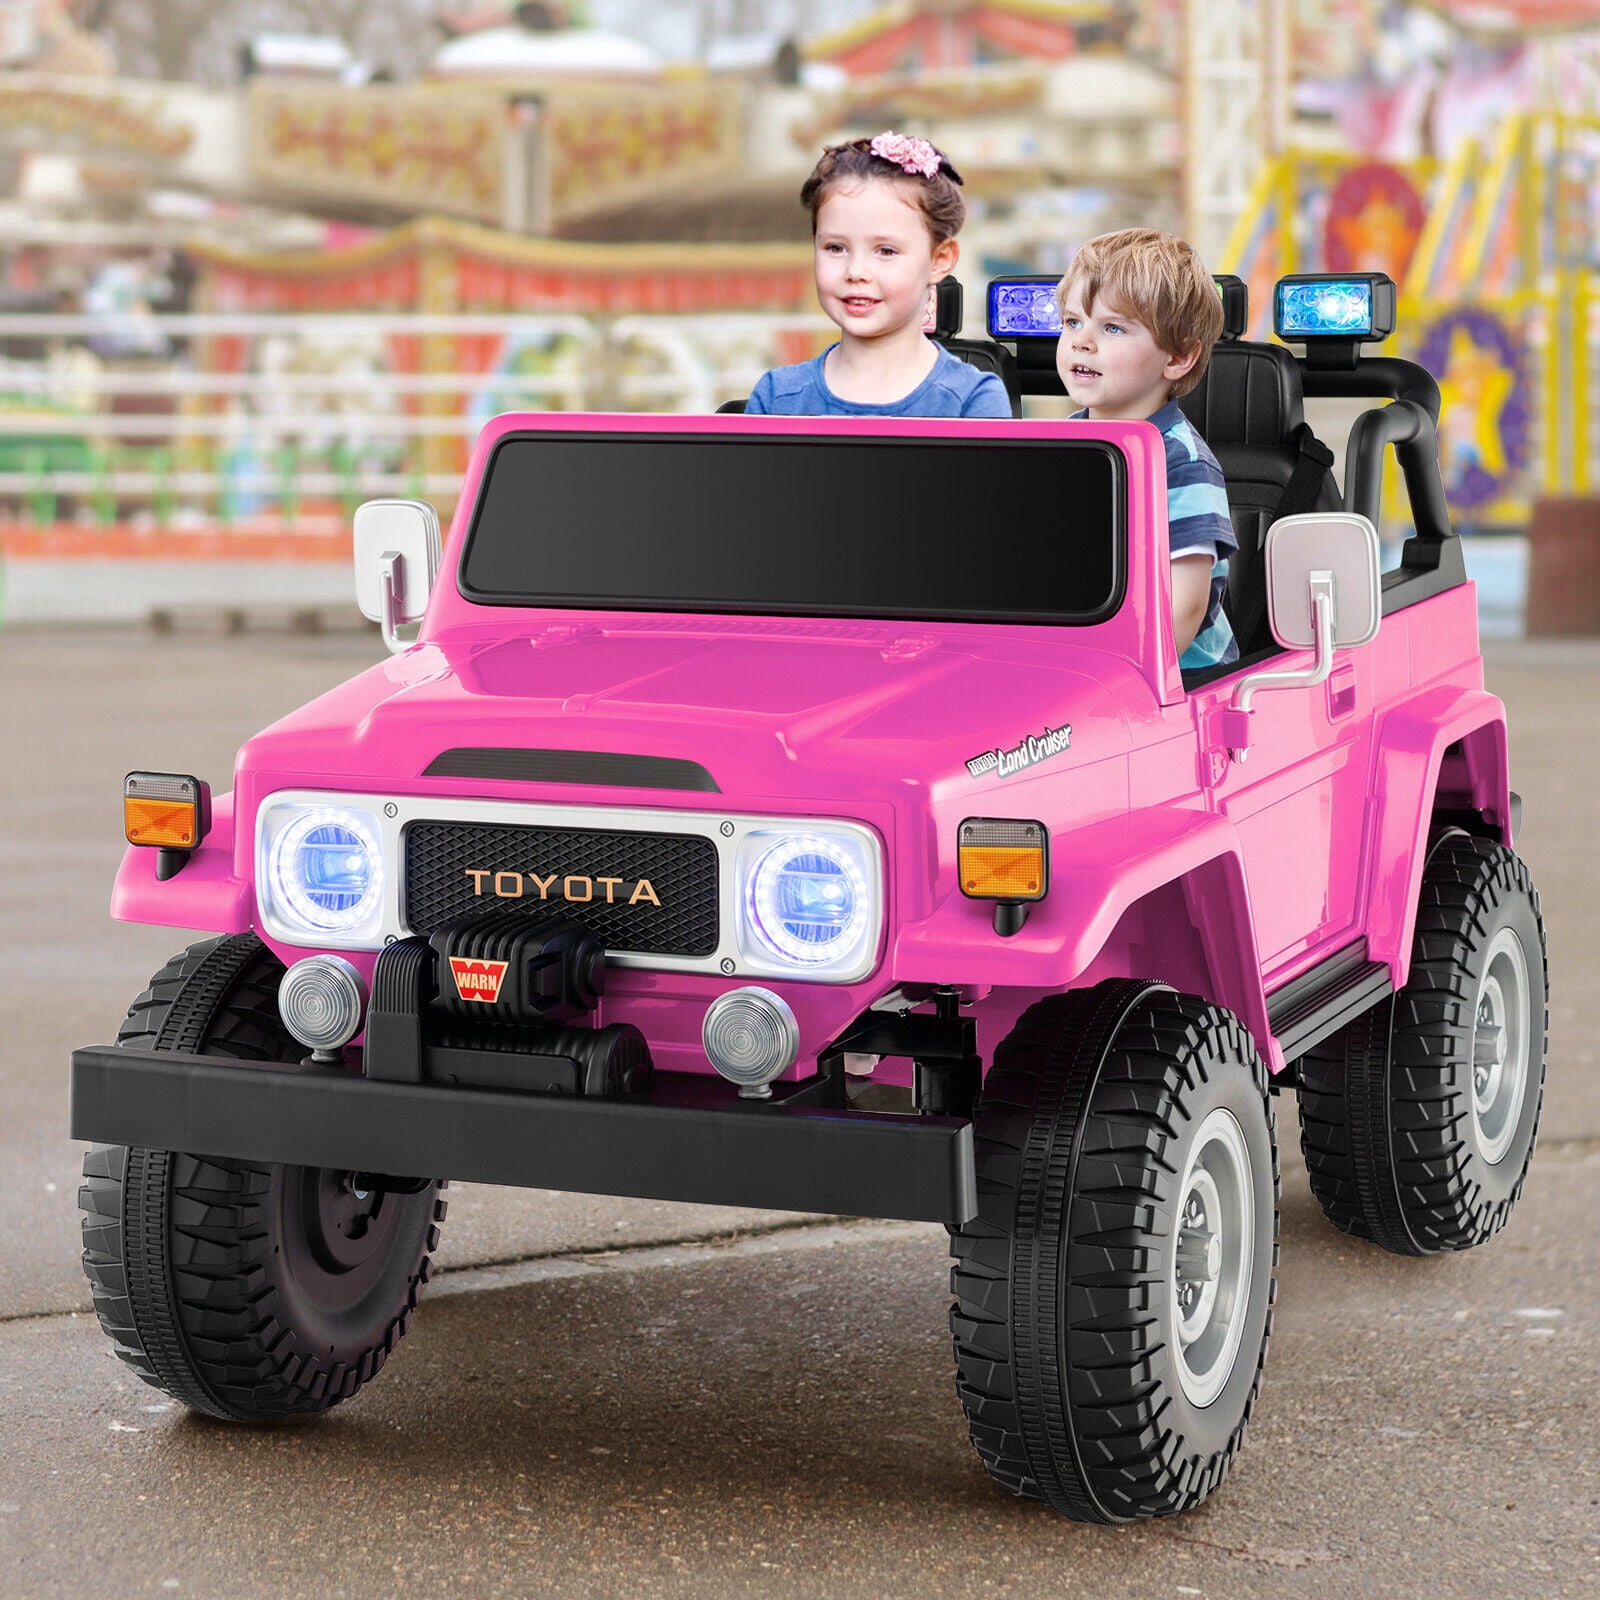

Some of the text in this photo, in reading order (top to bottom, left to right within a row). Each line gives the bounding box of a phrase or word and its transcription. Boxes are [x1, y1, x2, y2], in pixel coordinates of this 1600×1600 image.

[967, 726, 1071, 776] TOYOTA Land Cruiser
[465, 869, 662, 907] TOYOTA
[457, 971, 497, 991] WARN
